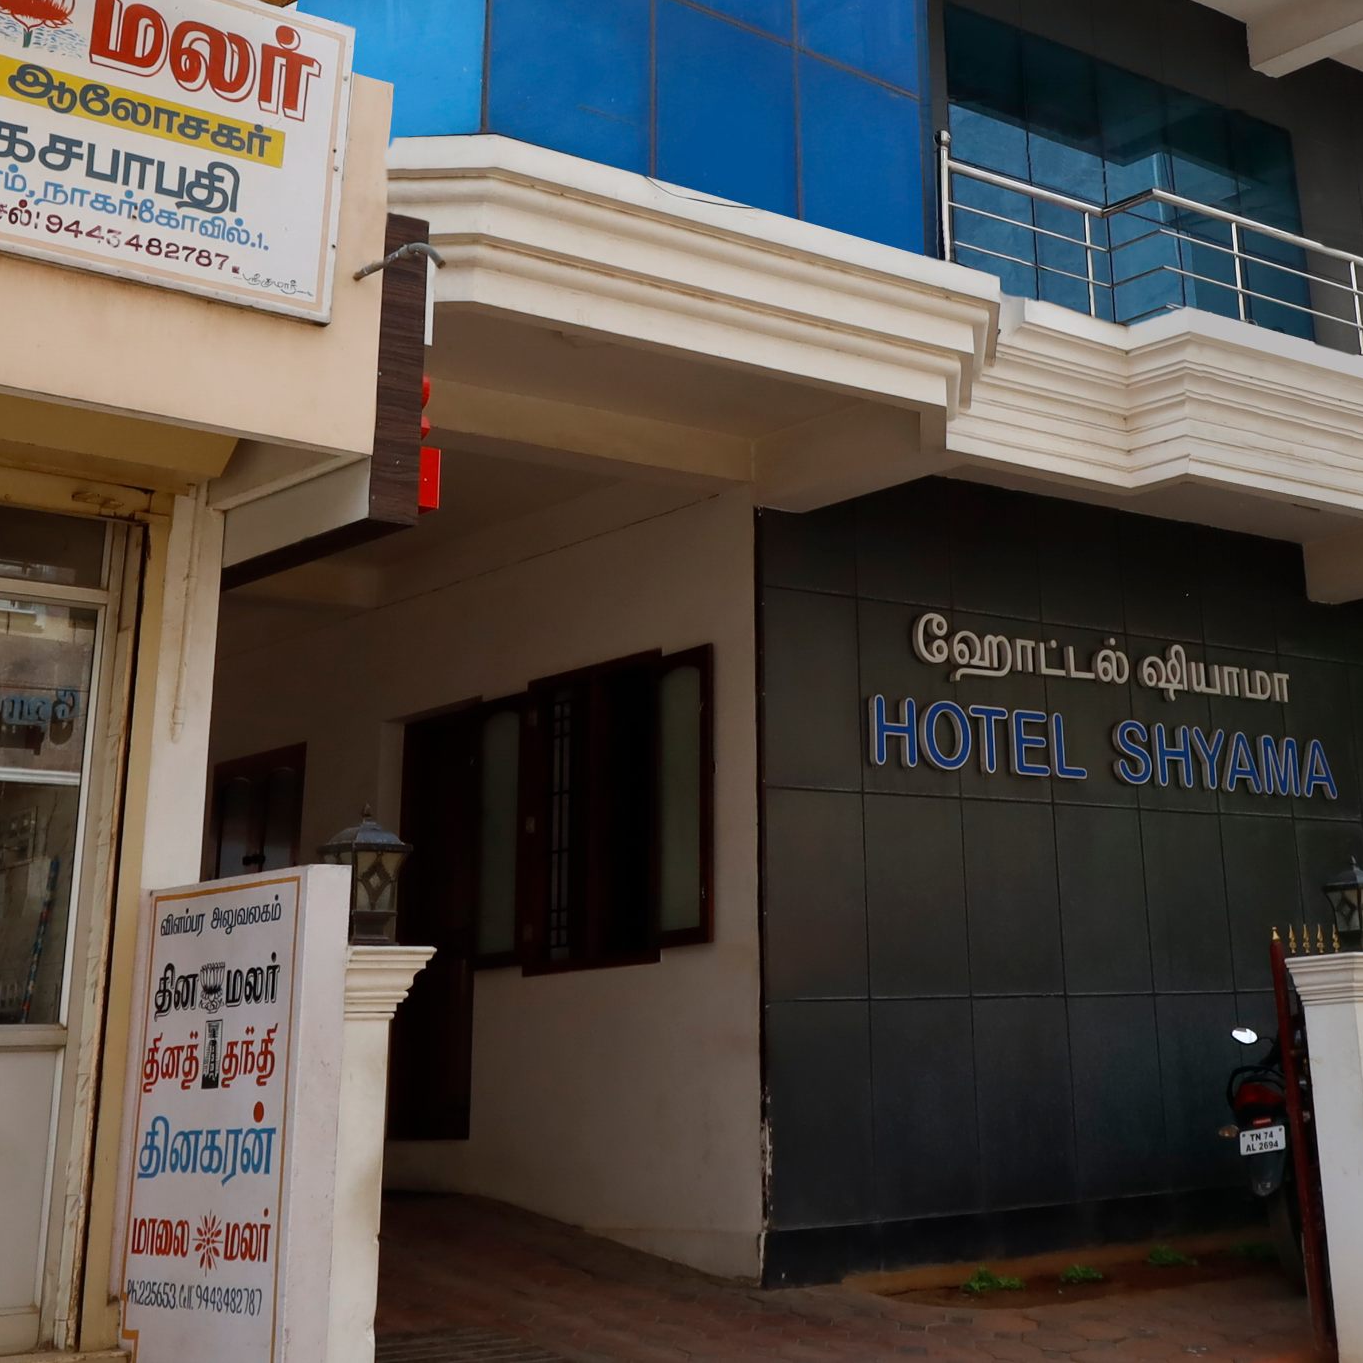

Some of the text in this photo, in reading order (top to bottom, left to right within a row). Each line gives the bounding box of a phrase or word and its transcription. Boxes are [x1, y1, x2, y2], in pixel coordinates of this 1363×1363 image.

[7, 59, 274, 159] ஆலோசகர்
[913, 612, 1291, 703] ஹோட்டல் ஷியாமா
[868, 693, 1338, 800] HOTEL SHYAMA
[160, 893, 282, 937] விளம்பர அலுவலகம்
[142, 1023, 279, 1094] தினத் தந்தி
[137, 1101, 277, 1188] தினகரன்
[1246, 1143, 1256, 1153] AL
[1249, 1131, 1274, 1142] TN 74
[131, 1207, 271, 1263] மாலை மலர்
[195, 1284, 263, 1317] 9443482787
